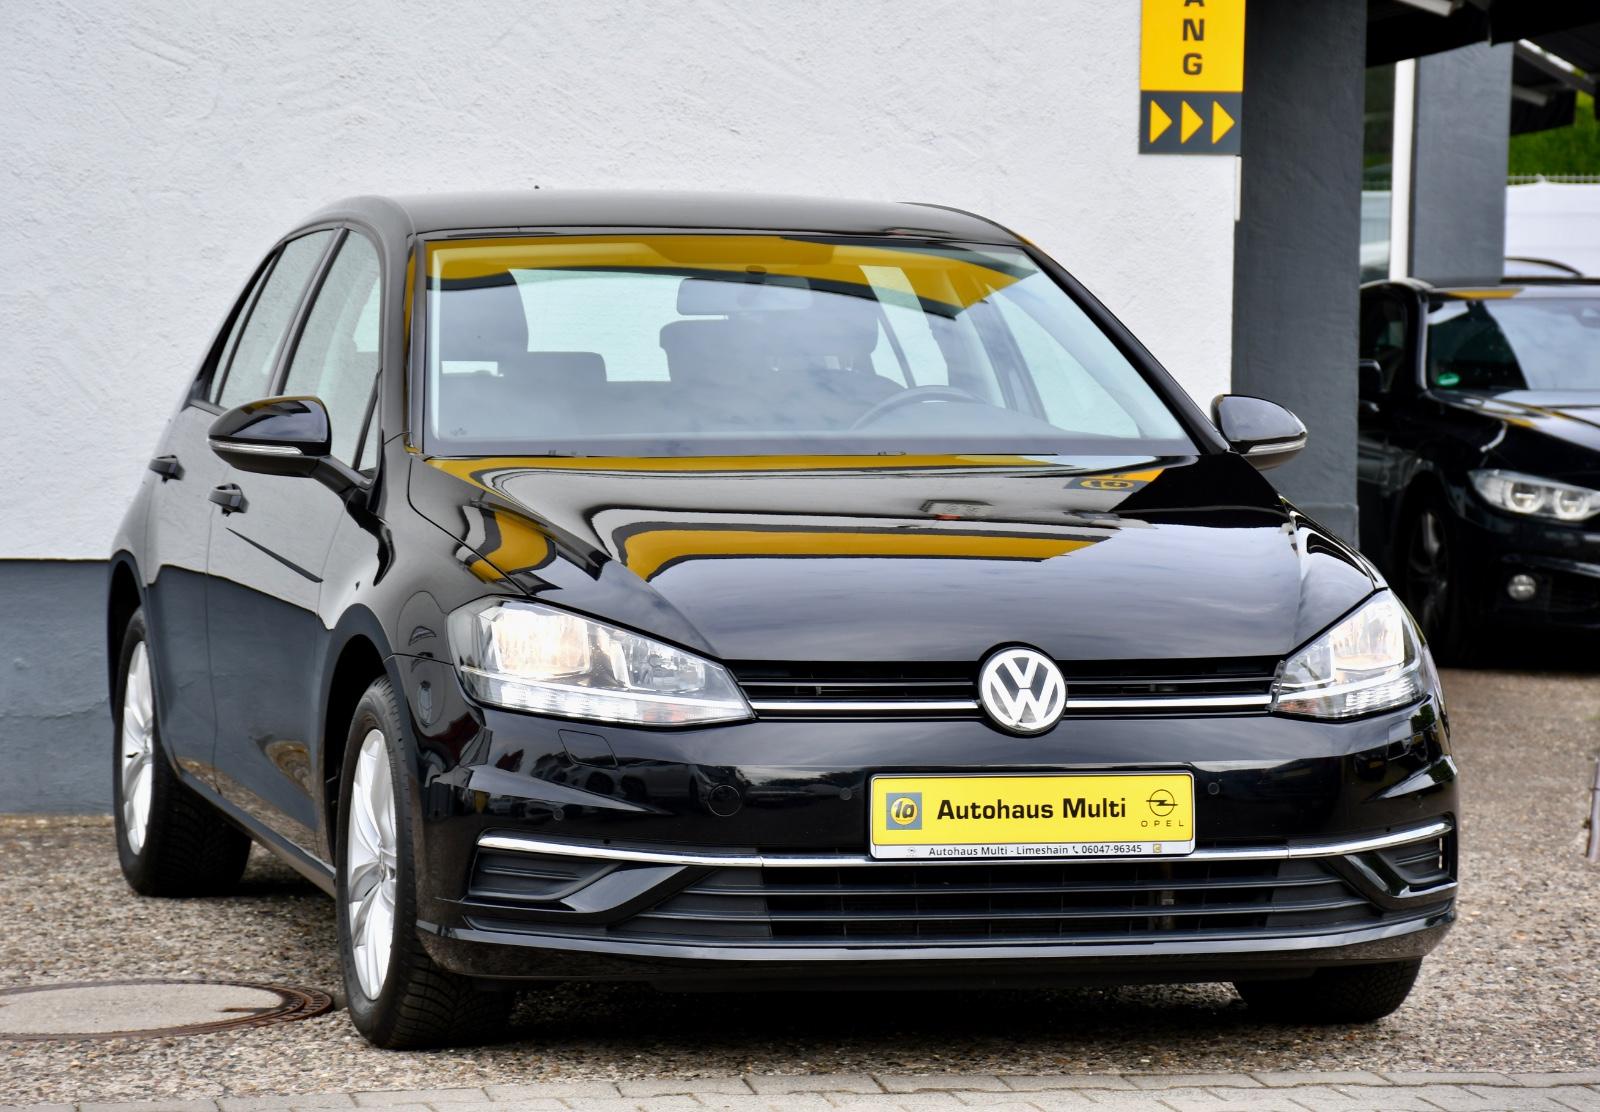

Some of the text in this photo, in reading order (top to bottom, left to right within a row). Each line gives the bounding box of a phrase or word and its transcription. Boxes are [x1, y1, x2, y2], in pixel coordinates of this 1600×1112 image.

[937, 797, 1126, 820] Autohaus Multi
[1140, 819, 1185, 828] OPEL
[928, 846, 979, 856] Autohaus
[981, 846, 1008, 856] Multi
[1016, 845, 1069, 855] Limeshain
[1081, 844, 1142, 854] 06047-96345
